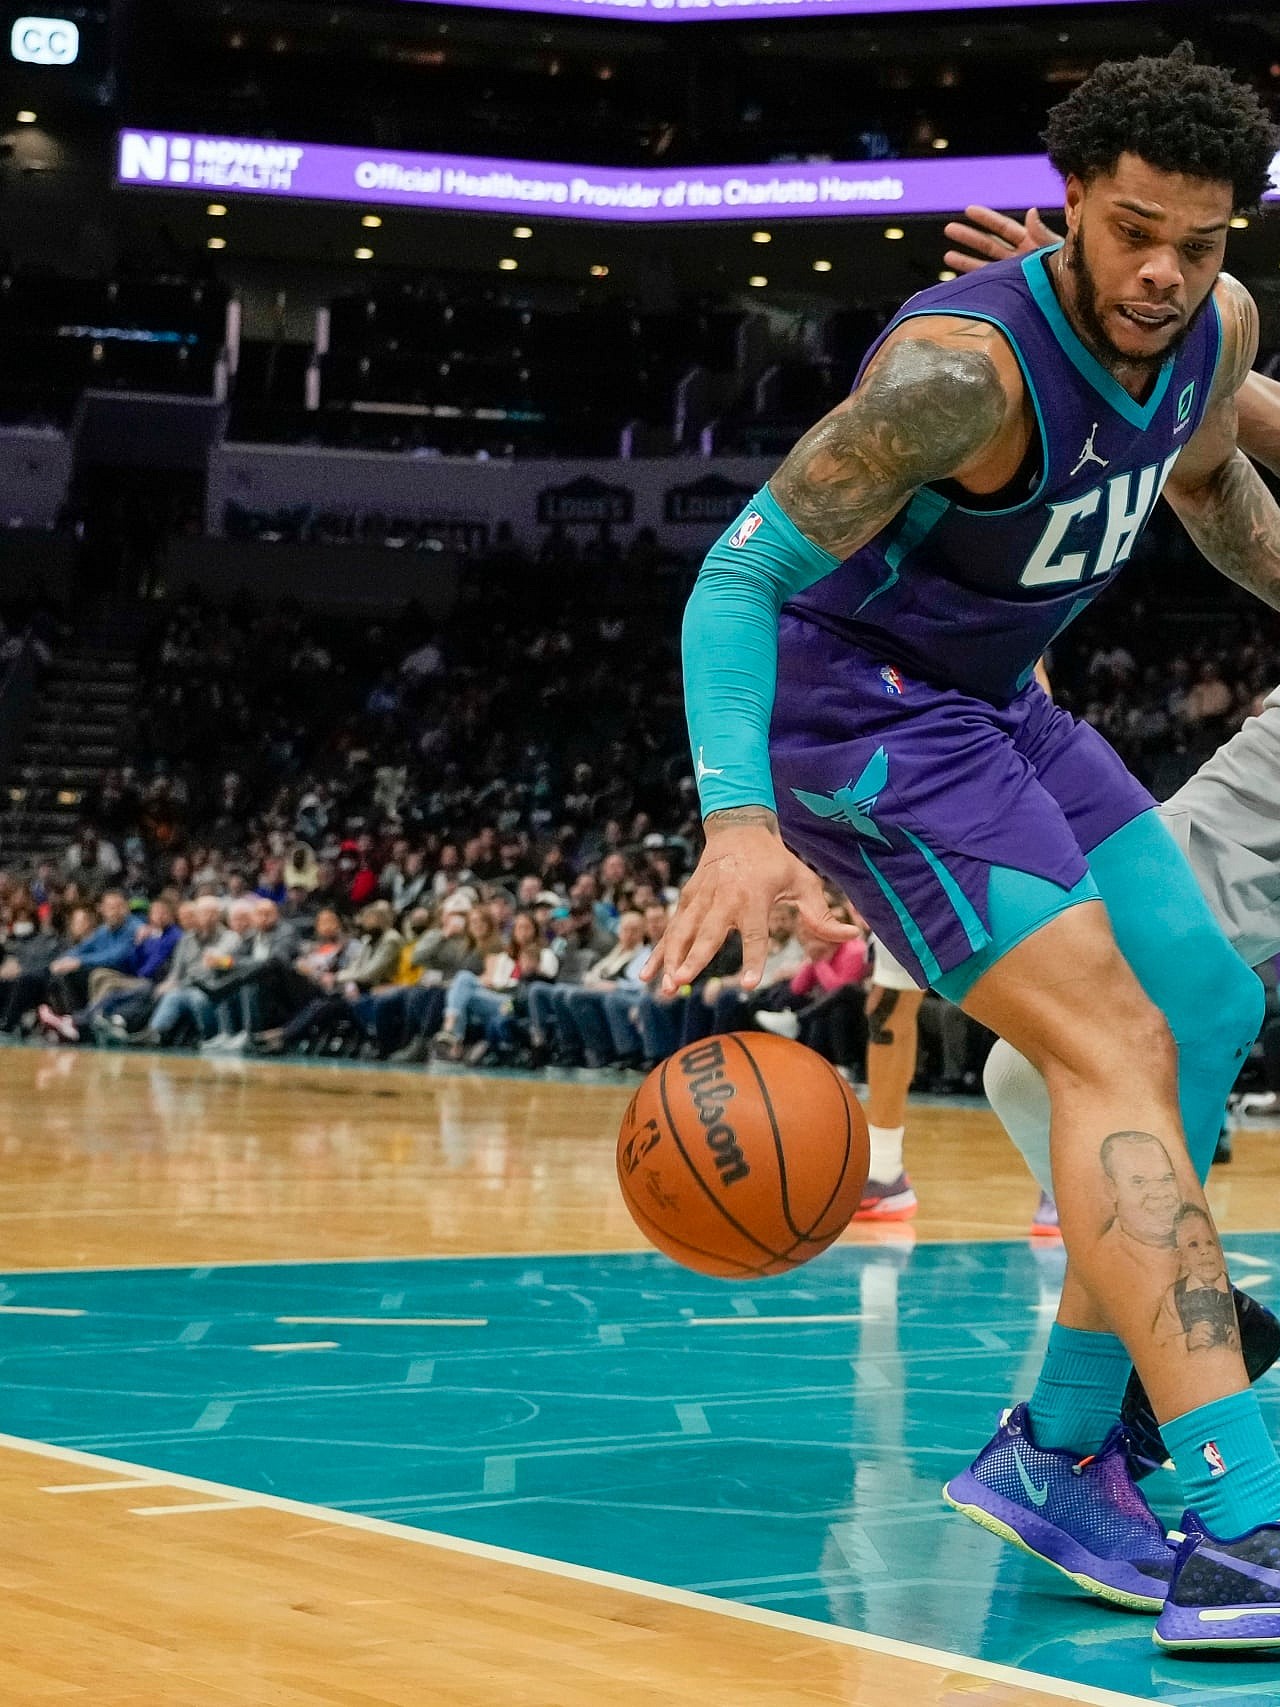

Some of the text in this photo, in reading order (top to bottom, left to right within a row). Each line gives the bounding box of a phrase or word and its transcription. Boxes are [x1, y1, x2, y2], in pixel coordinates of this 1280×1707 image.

[194, 140, 303, 168] NOVANT
[194, 163, 293, 190] HEALTH
[355, 162, 904, 208] Official Healthcare Provider of the Charlotte Hornets
[1018, 444, 1182, 588] CH
[679, 1040, 751, 1188] Wilson
